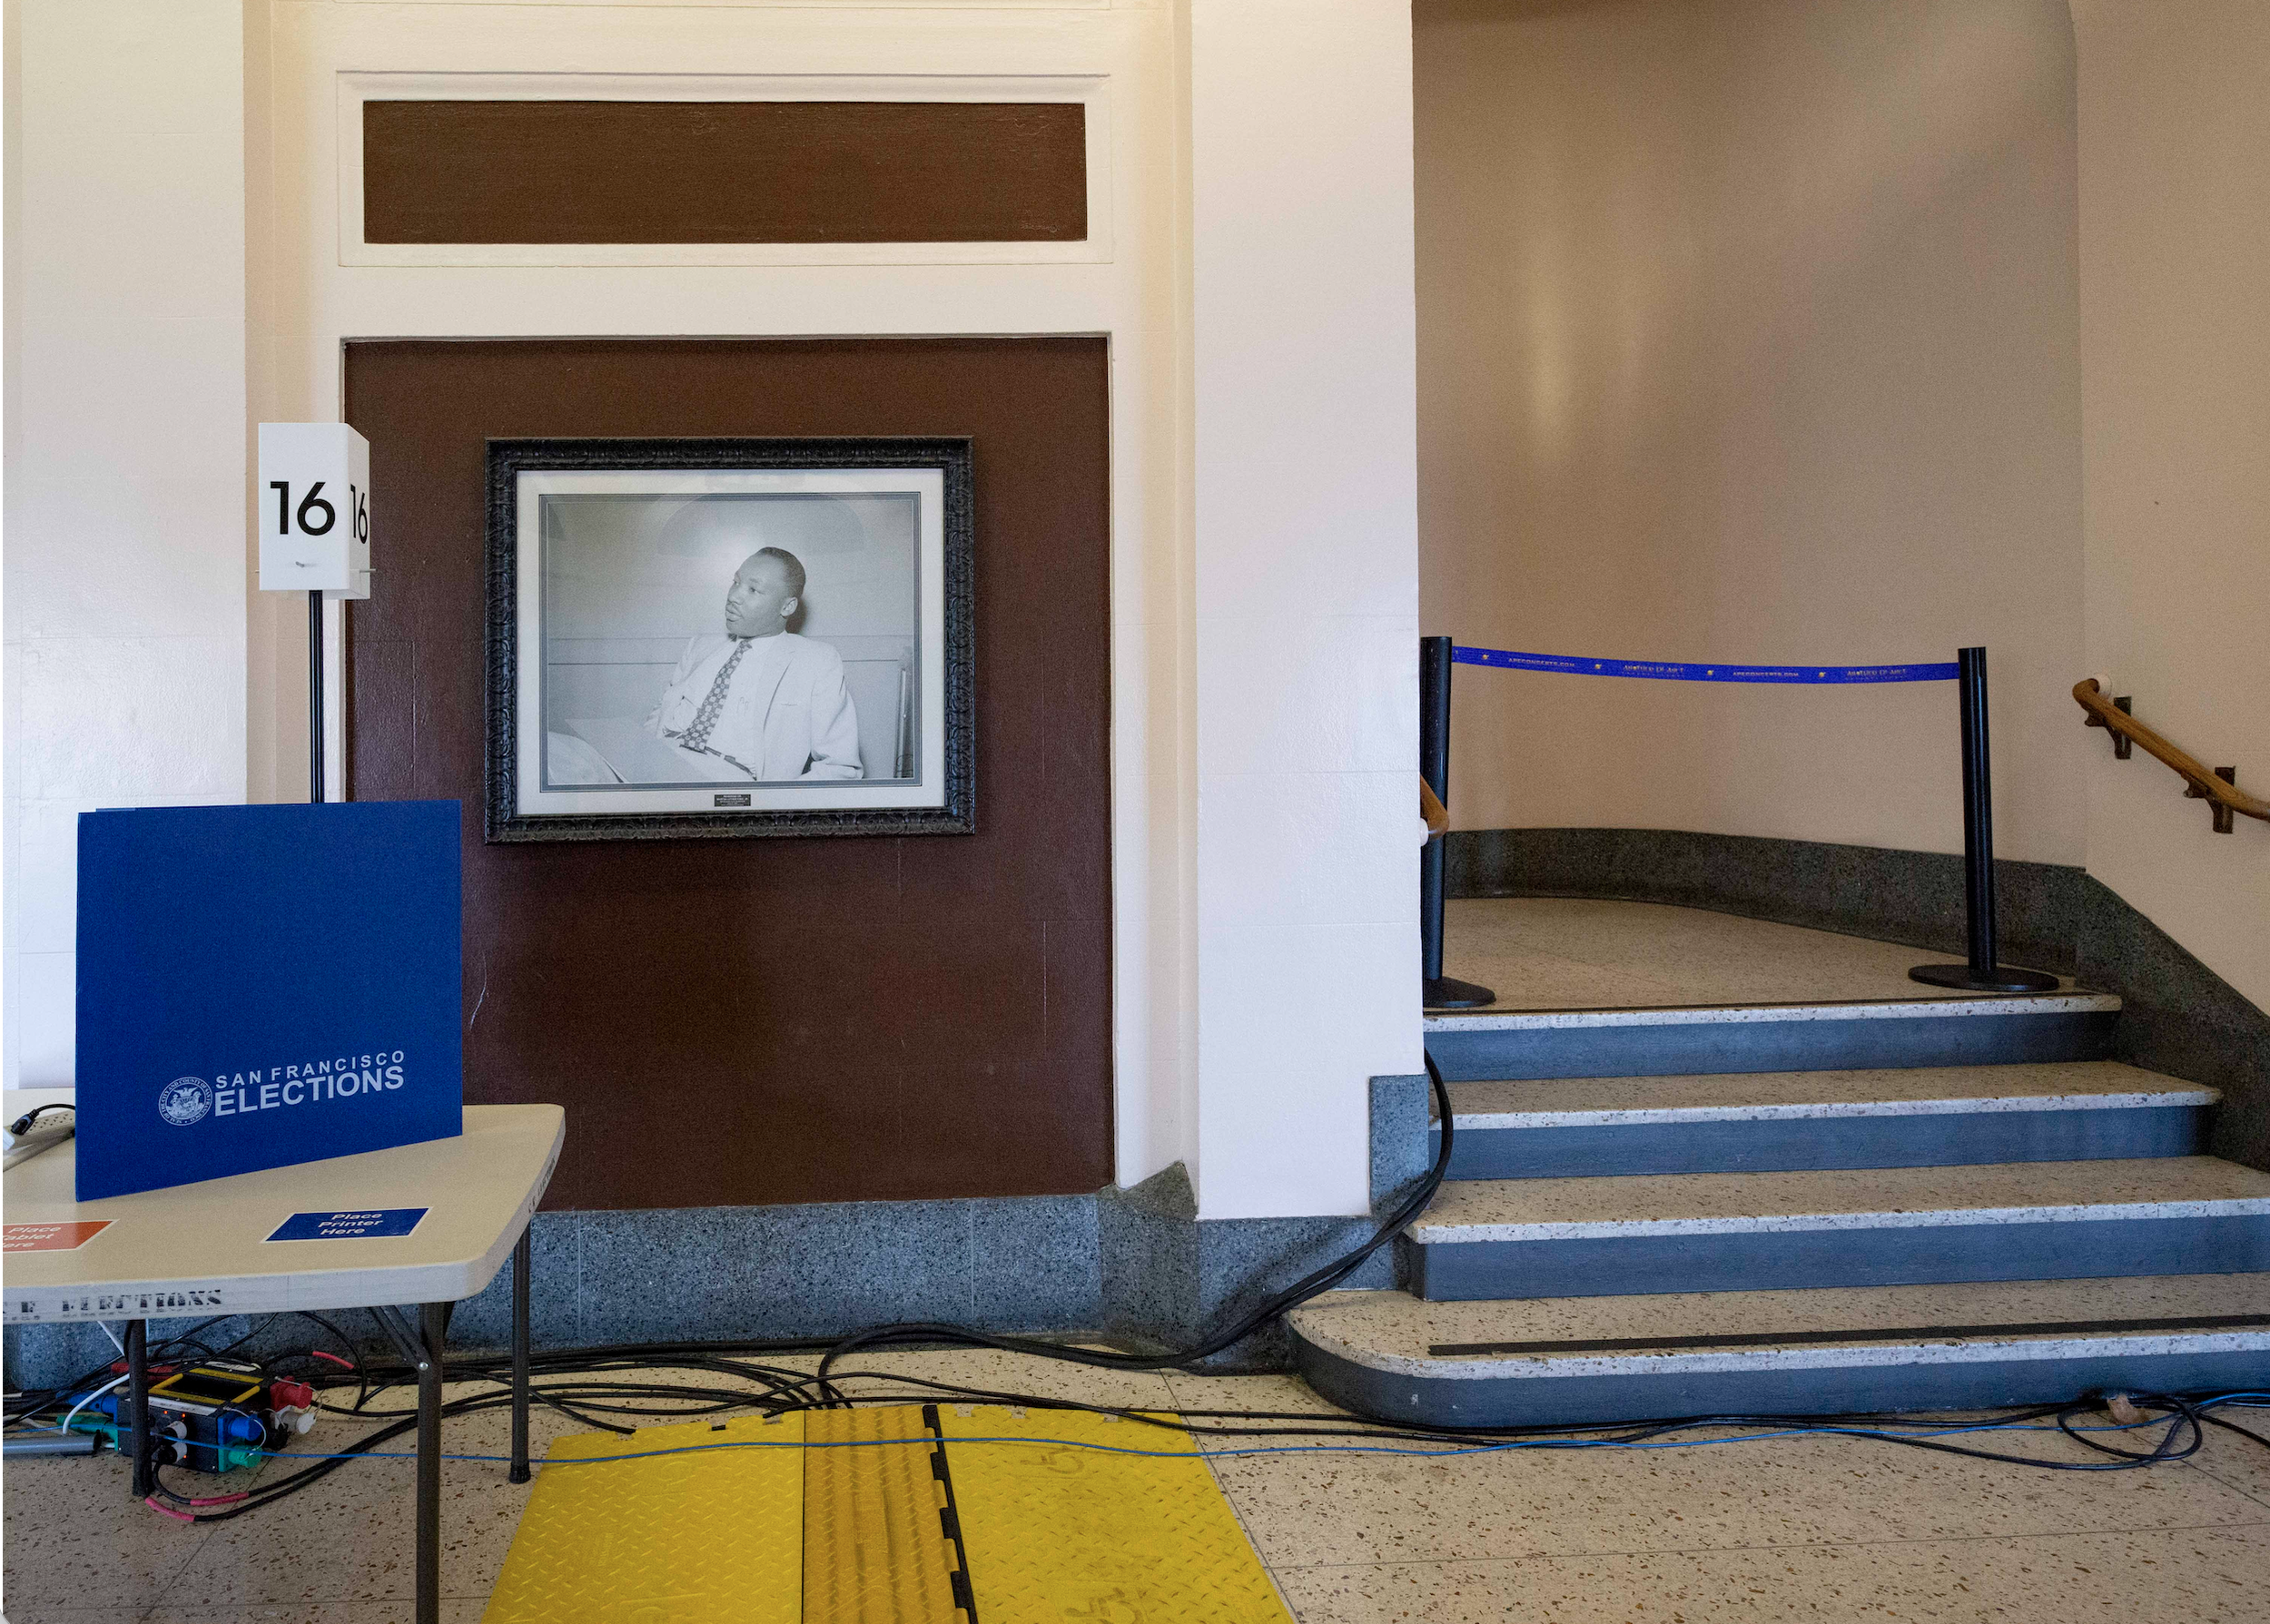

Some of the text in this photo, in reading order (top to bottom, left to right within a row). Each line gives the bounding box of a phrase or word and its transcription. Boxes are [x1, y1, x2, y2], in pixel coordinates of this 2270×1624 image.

[271, 481, 336, 536] 16
[350, 484, 369, 545] 16
[214, 1065, 405, 1117] ELECTIONS
[216, 1050, 405, 1089] SAN FRANCISCO
